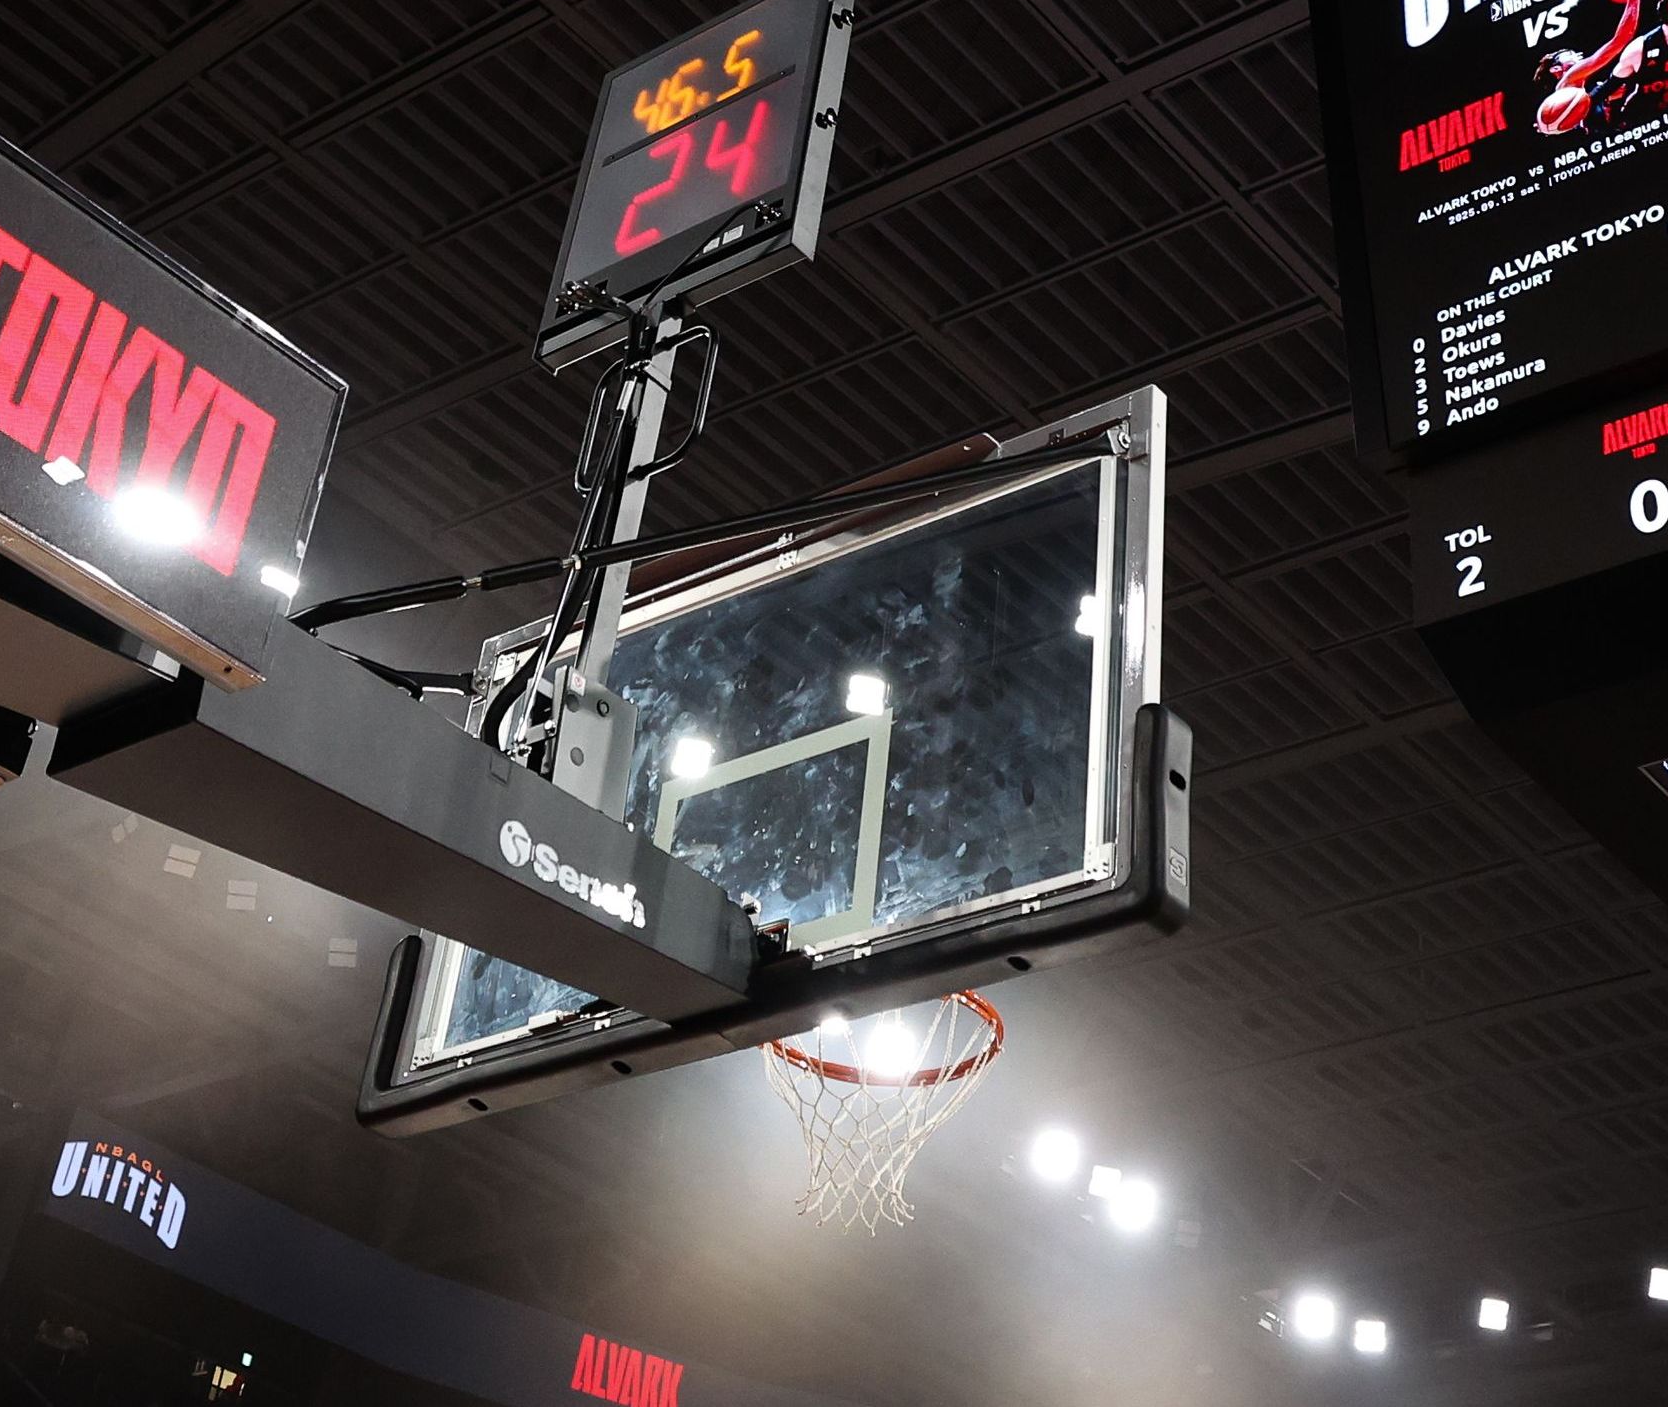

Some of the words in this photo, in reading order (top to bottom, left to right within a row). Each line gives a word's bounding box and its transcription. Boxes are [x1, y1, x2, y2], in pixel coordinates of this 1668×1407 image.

[1522, 2, 1572, 48] VS
[1399, 92, 1508, 172] ALVARK
[615, 98, 769, 257] 24
[1418, 194, 1469, 223] ALVARK
[1471, 176, 1516, 201] TOKYO
[1554, 147, 1588, 168] NBA
[1590, 141, 1602, 154] G
[1605, 119, 1660, 149] League
[1438, 149, 1471, 172] TOKYO
[1448, 192, 1514, 225] 2025.09.13
[1520, 183, 1541, 196] sat
[1601, 145, 1636, 165] ARENA
[1488, 238, 1579, 285] ALVARK
[1581, 205, 1665, 248] TOKYO
[1436, 304, 1461, 322] ON
[1464, 291, 1495, 312] THE
[1498, 269, 1553, 299] COURT
[1412, 338, 1426, 353] 0
[1441, 310, 1506, 343] Davies
[1414, 358, 1426, 374] 2
[1442, 332, 1502, 363] Okura
[1415, 378, 1427, 394] 3
[1443, 352, 1505, 383] Toews
[1417, 398, 1429, 415] 5
[1445, 358, 1546, 405] Nakamura
[1417, 419, 1430, 436] 9
[1446, 397, 1499, 426] Ando
[1444, 525, 1491, 551] TOL
[1456, 554, 1486, 598] 2
[52, 1142, 186, 1249] UNITED
[571, 1333, 684, 1407] ALVARK
